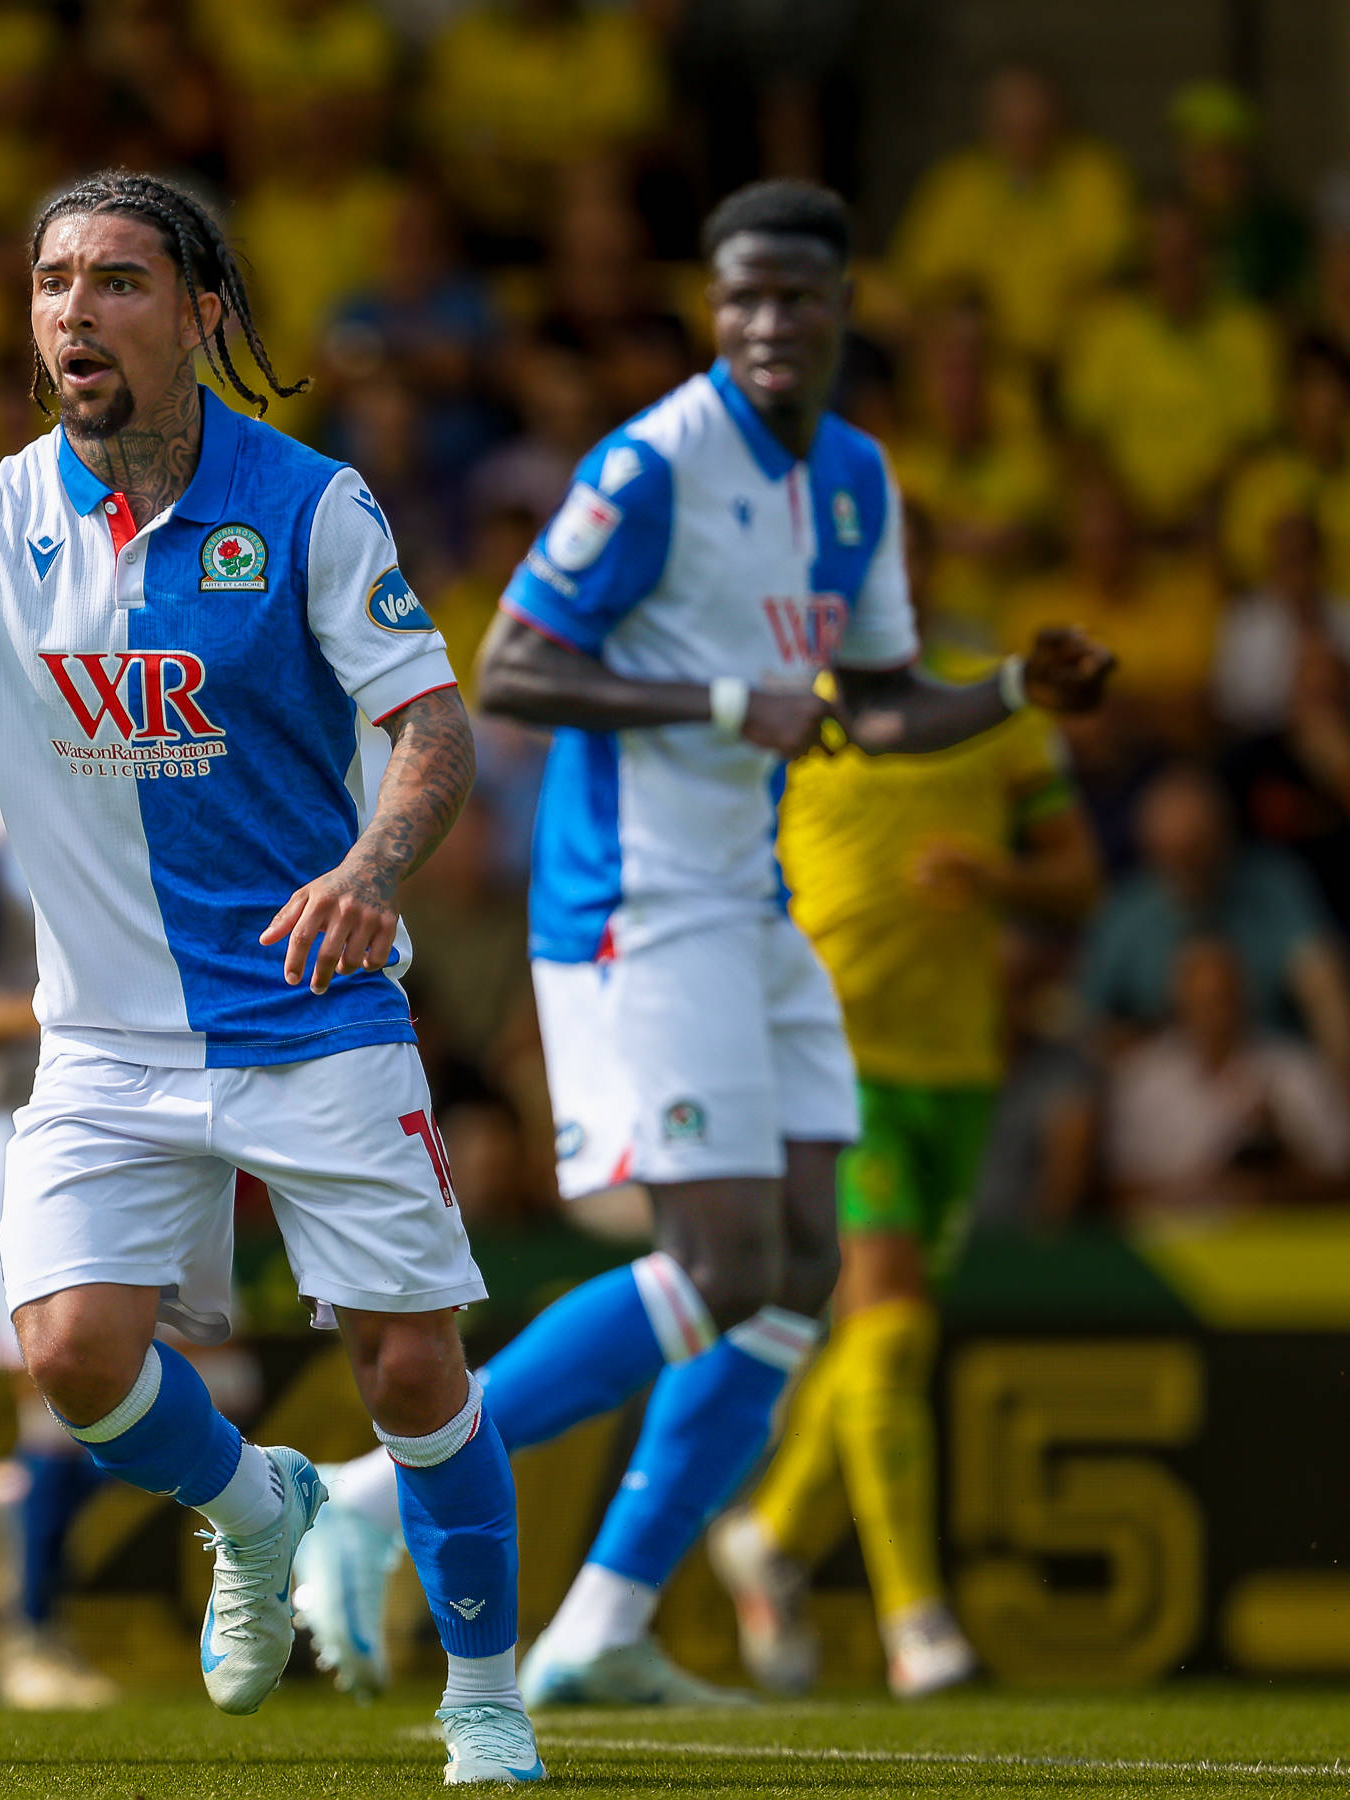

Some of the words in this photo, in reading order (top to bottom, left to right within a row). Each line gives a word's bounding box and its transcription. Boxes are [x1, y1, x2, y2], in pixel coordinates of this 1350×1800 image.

[204, 526, 234, 571] BLACKBURN
[235, 526, 264, 554] ROVERS
[37, 652, 226, 741] WR
[70, 762, 210, 777] SOLICITORS
